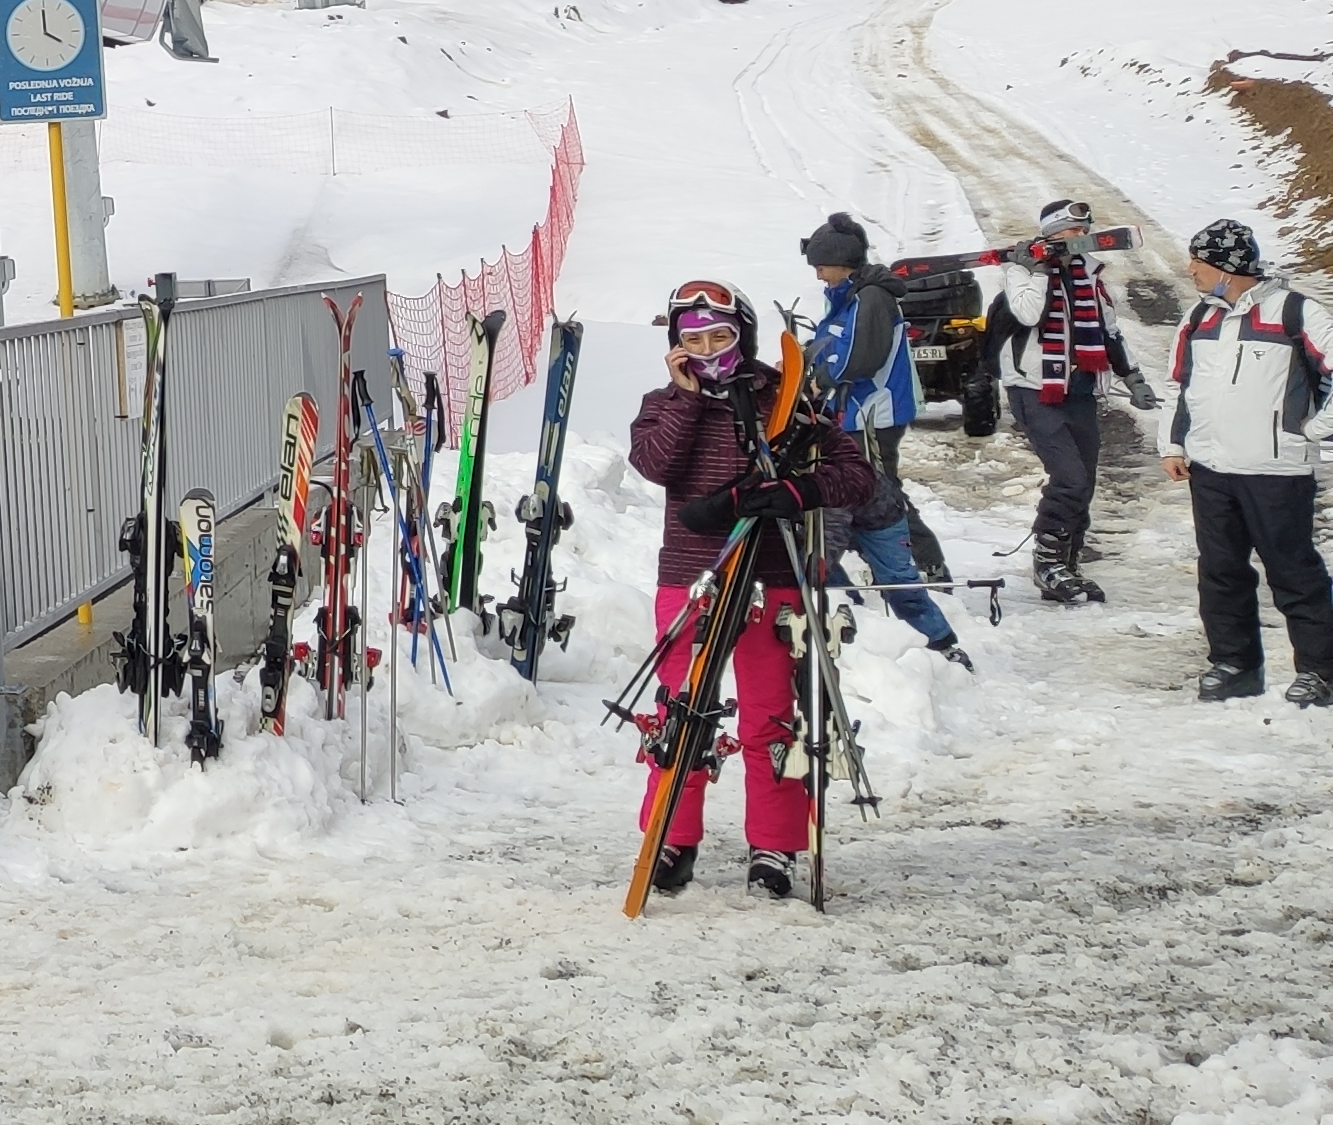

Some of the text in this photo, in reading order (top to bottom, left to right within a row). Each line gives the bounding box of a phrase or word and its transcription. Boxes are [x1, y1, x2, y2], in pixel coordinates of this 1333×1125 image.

[9, 77, 94, 90] POSLEDNJA VOŽNJA
[30, 92, 74, 102] LAST RIDE
[557, 351, 575, 418] elan
[280, 413, 300, 502] elan
